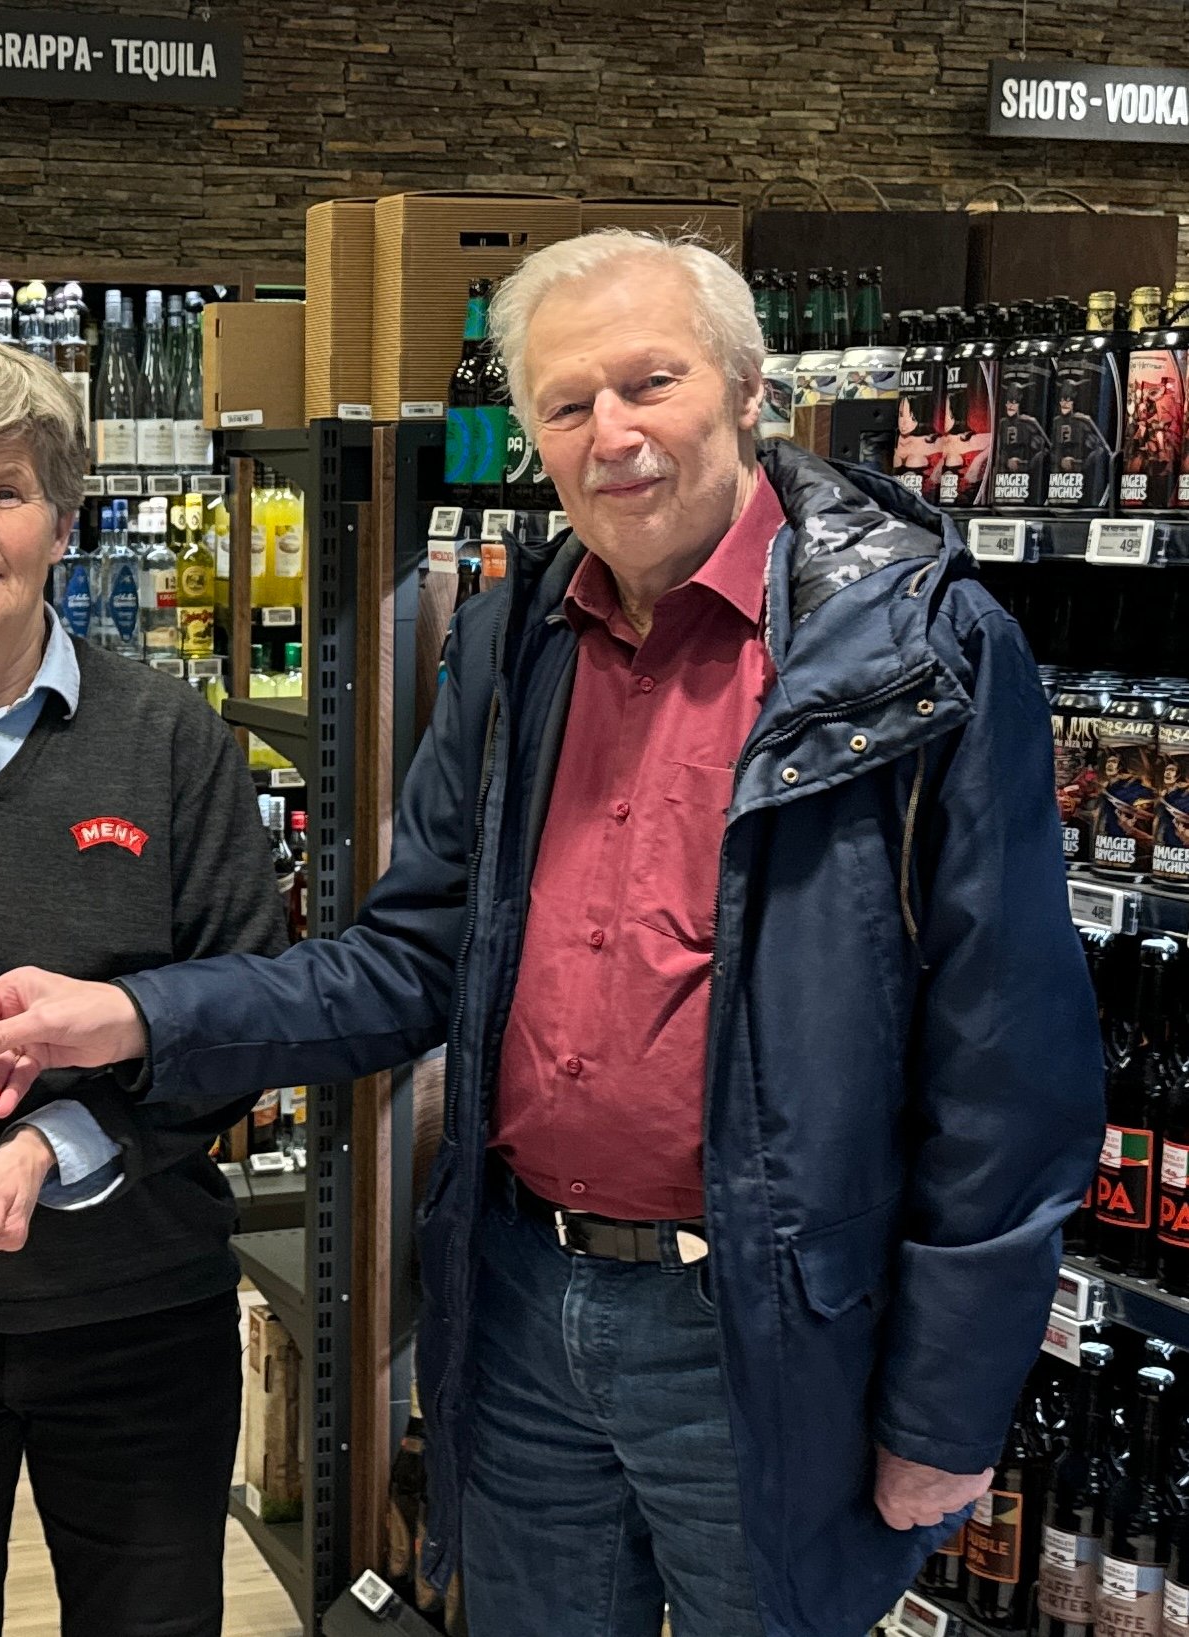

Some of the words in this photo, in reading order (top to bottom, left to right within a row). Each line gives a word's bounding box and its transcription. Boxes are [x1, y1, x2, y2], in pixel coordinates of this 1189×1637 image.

[111, 39, 217, 82] TEQUILA
[80, 822, 141, 846] MENY
[1100, 1607, 1145, 1630] AFFE
